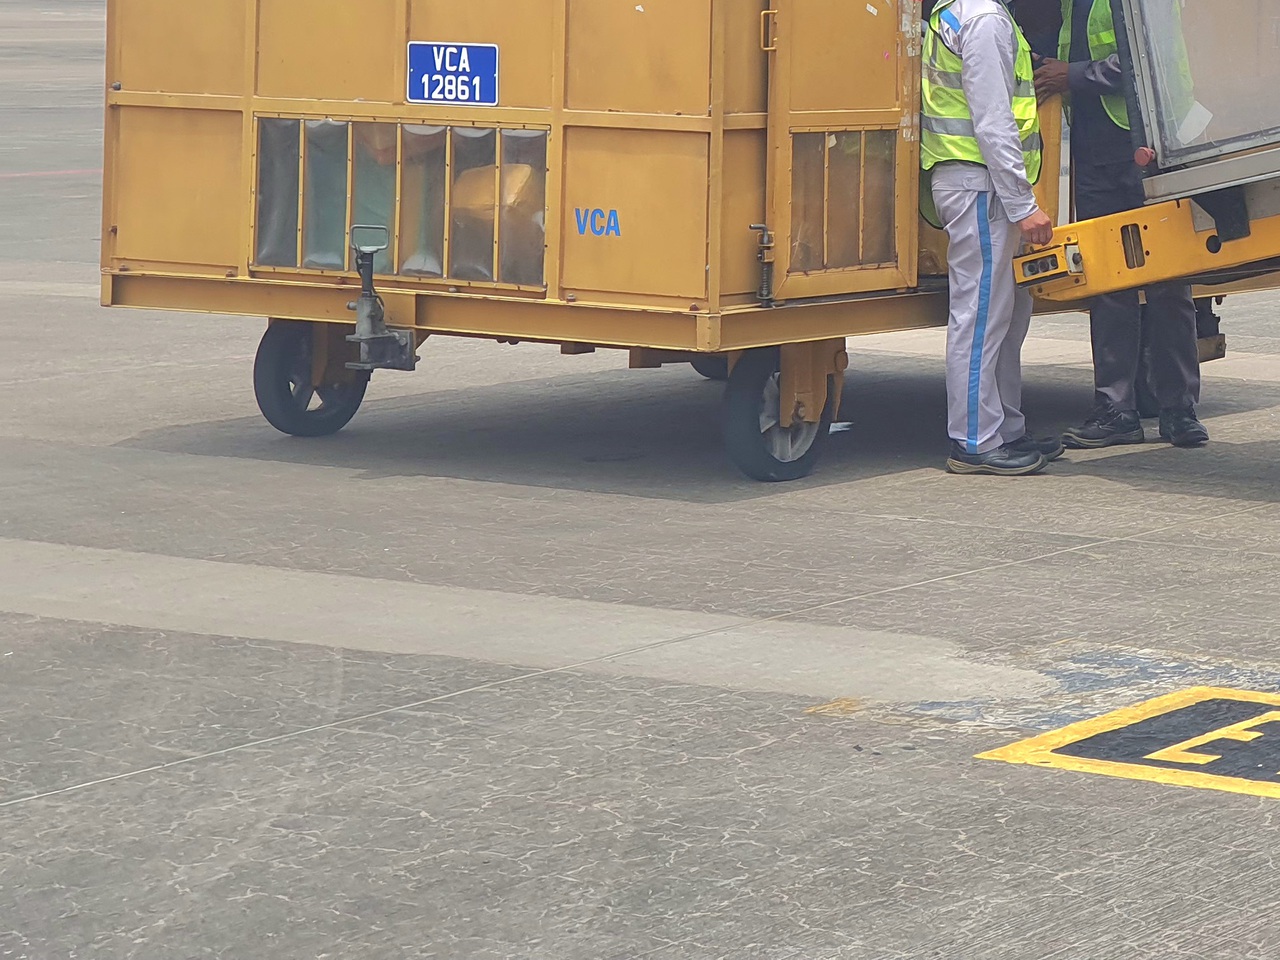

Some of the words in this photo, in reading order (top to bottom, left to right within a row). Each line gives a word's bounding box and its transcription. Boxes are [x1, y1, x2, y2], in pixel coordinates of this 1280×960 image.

[432, 46, 471, 72] VCA
[420, 74, 480, 101] 12861
[576, 209, 620, 236] VCA
